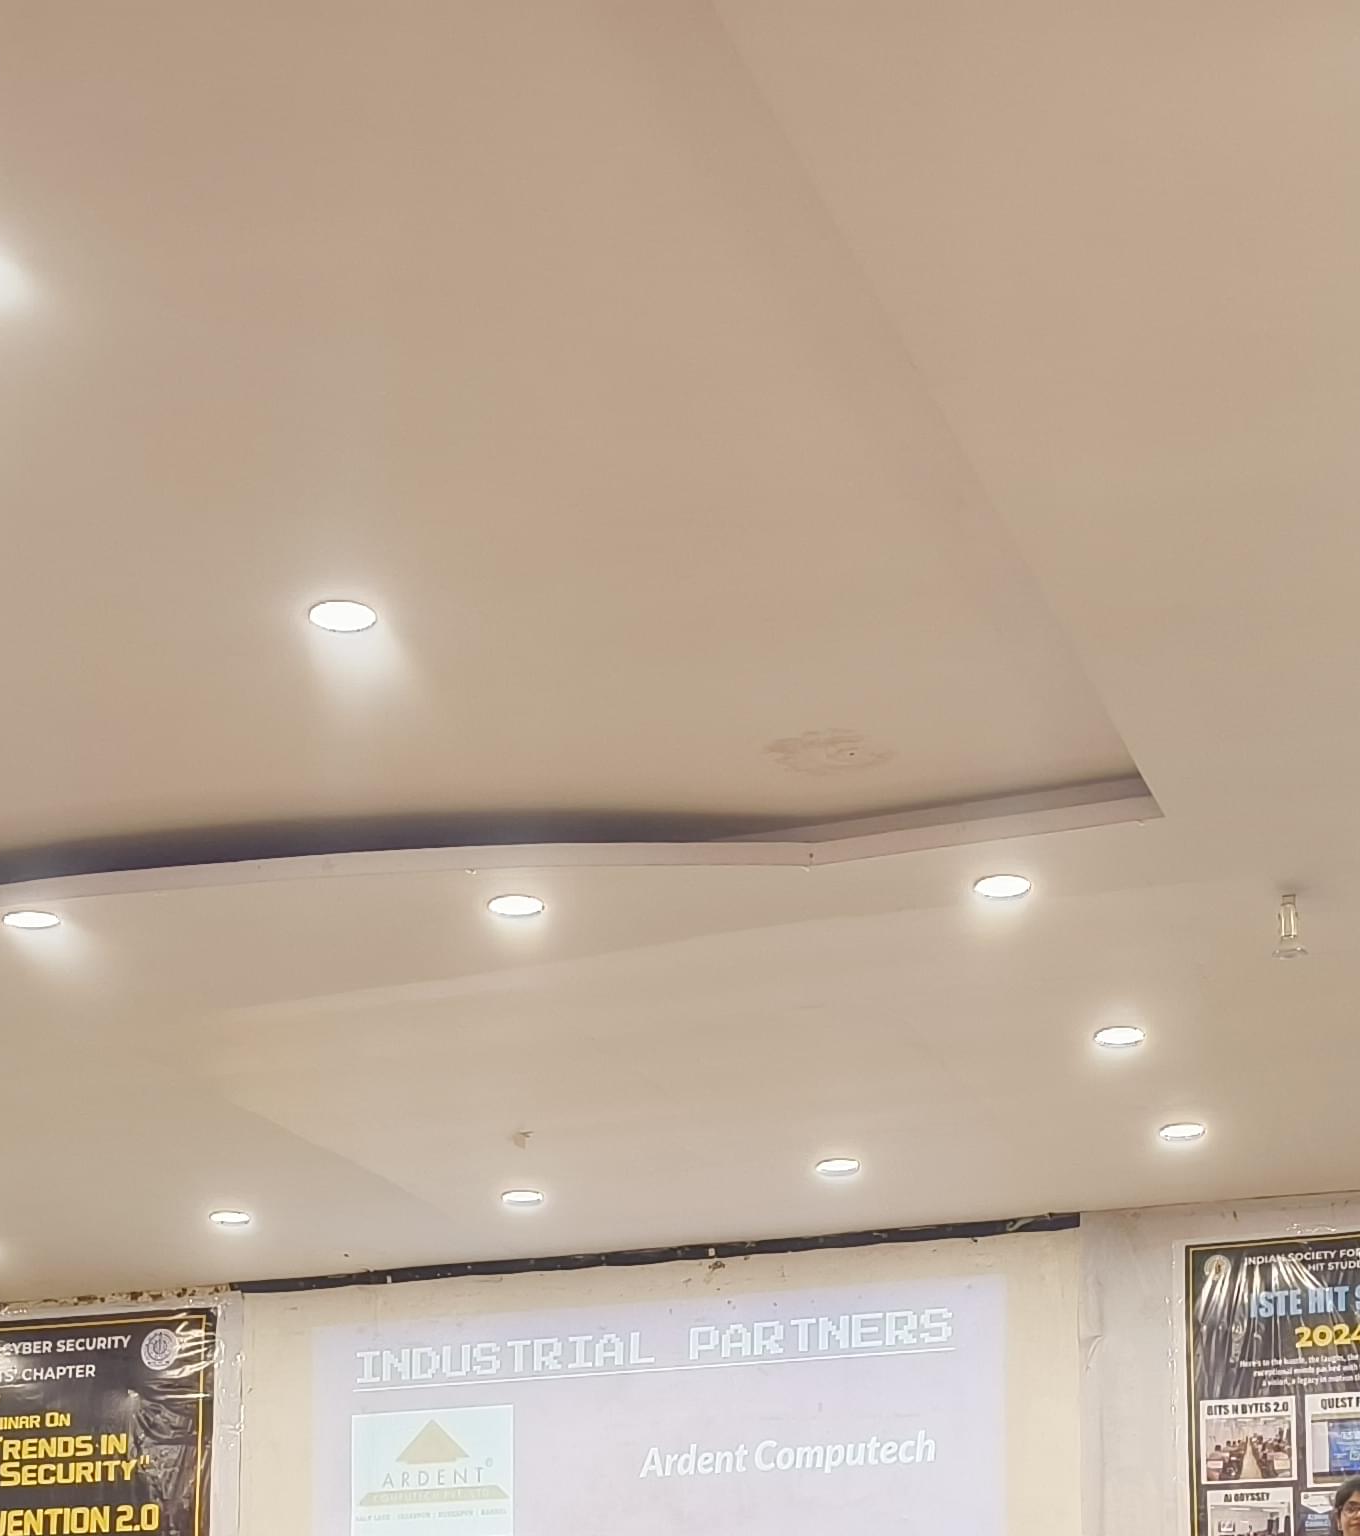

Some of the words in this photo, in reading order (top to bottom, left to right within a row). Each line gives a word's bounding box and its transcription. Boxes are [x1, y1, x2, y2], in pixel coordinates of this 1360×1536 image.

[1244, 1254, 1288, 1266] INDIAN
[1289, 1251, 1336, 1263] SOCIETY
[1308, 1263, 1325, 1273] HIT
[1250, 1290, 1302, 1319] ISTE
[1308, 1286, 1350, 1315] HIT
[56, 1335, 132, 1354] SECURITY
[355, 1330, 656, 1386] INDUSTRIAL
[689, 1306, 954, 1362] PARTNERS
[21, 1364, 97, 1381] CHAPTER
[1241, 1403, 1272, 1415] BYTES
[1273, 1402, 1289, 1413] 2.0
[1320, 1397, 1353, 1410] QUEST
[100, 1433, 128, 1455] IN
[639, 1441, 749, 1479] Ardent
[753, 1429, 937, 1479] Computech
[382, 1466, 484, 1489] ARDENT
[115, 1504, 160, 1533] 2.0
